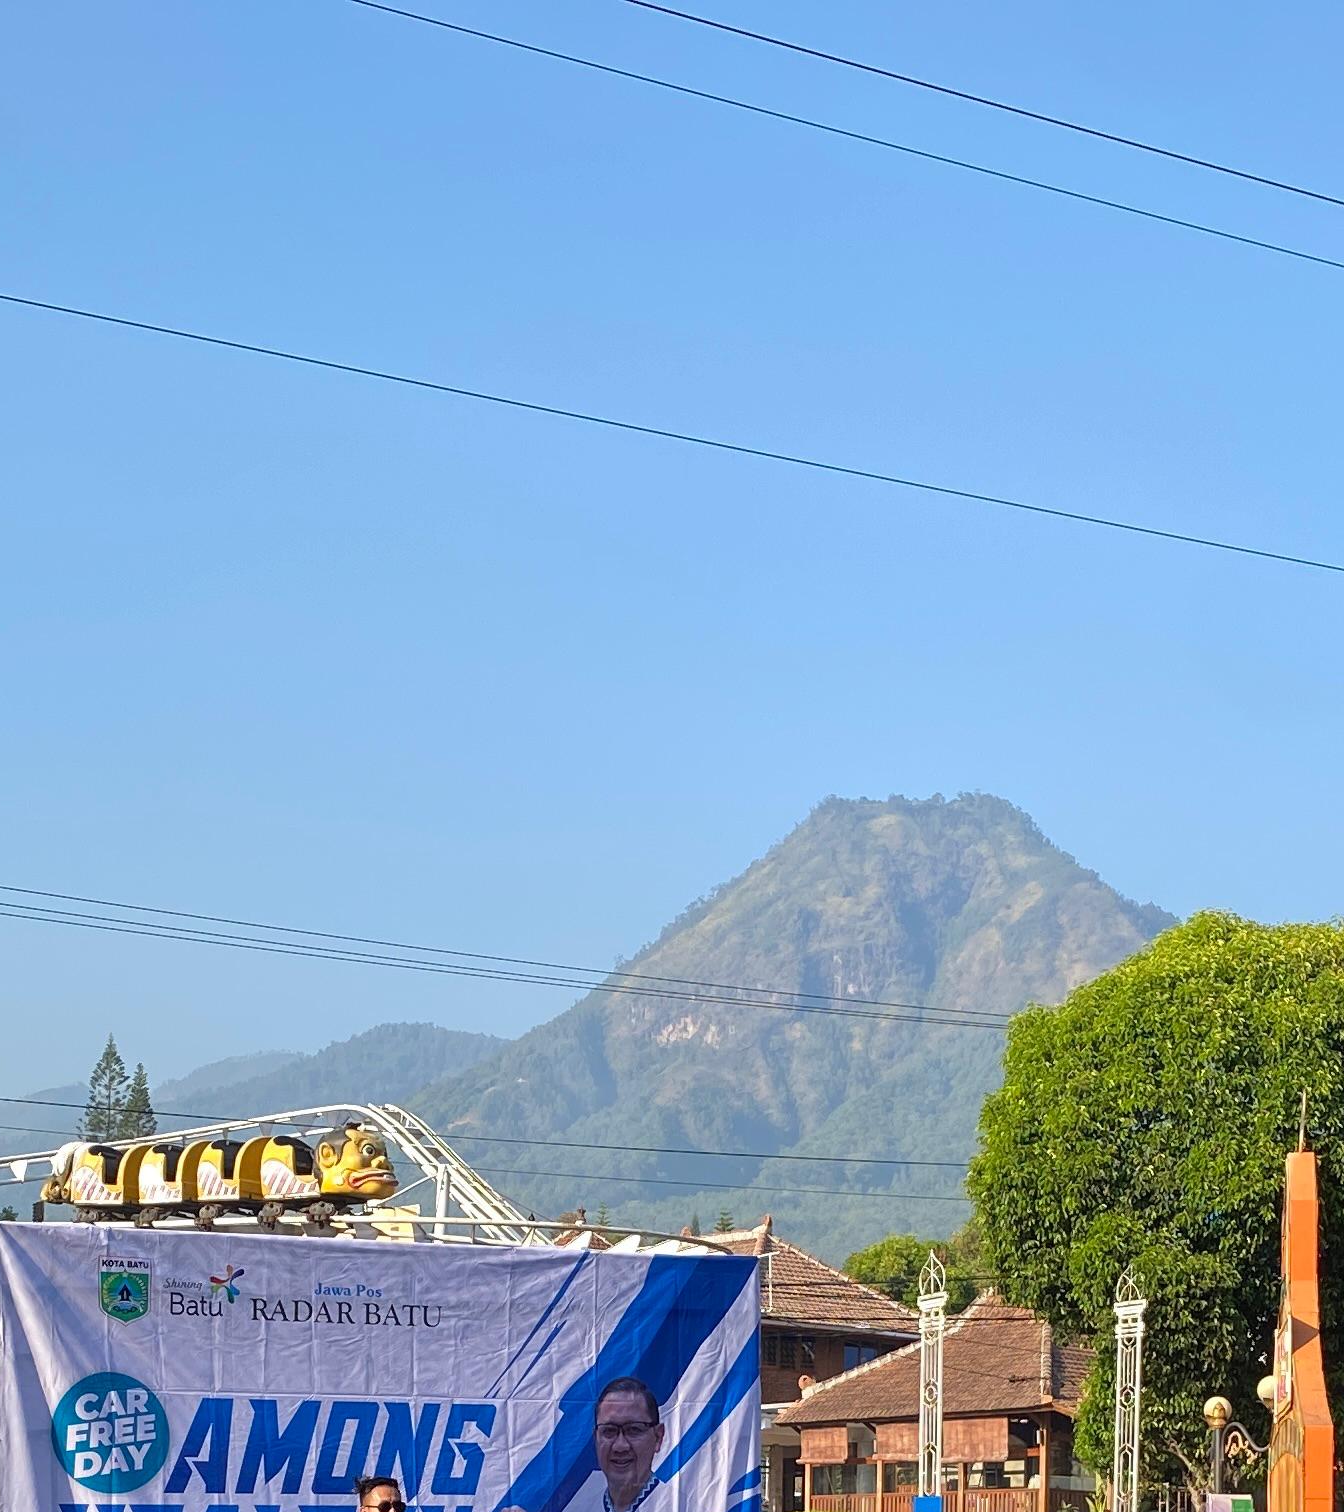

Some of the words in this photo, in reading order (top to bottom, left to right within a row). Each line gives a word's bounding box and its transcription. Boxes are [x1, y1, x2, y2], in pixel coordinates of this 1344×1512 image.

[170, 1292, 223, 1317] Batu
[314, 1283, 351, 1297] Jawa
[356, 1284, 382, 1298] Pos
[250, 1298, 355, 1324] RADAR
[364, 1303, 442, 1327] BATU
[75, 1388, 148, 1420] CAR
[66, 1414, 156, 1451] FREE
[73, 1443, 152, 1479] DAY
[164, 1398, 498, 1501] AMONG
